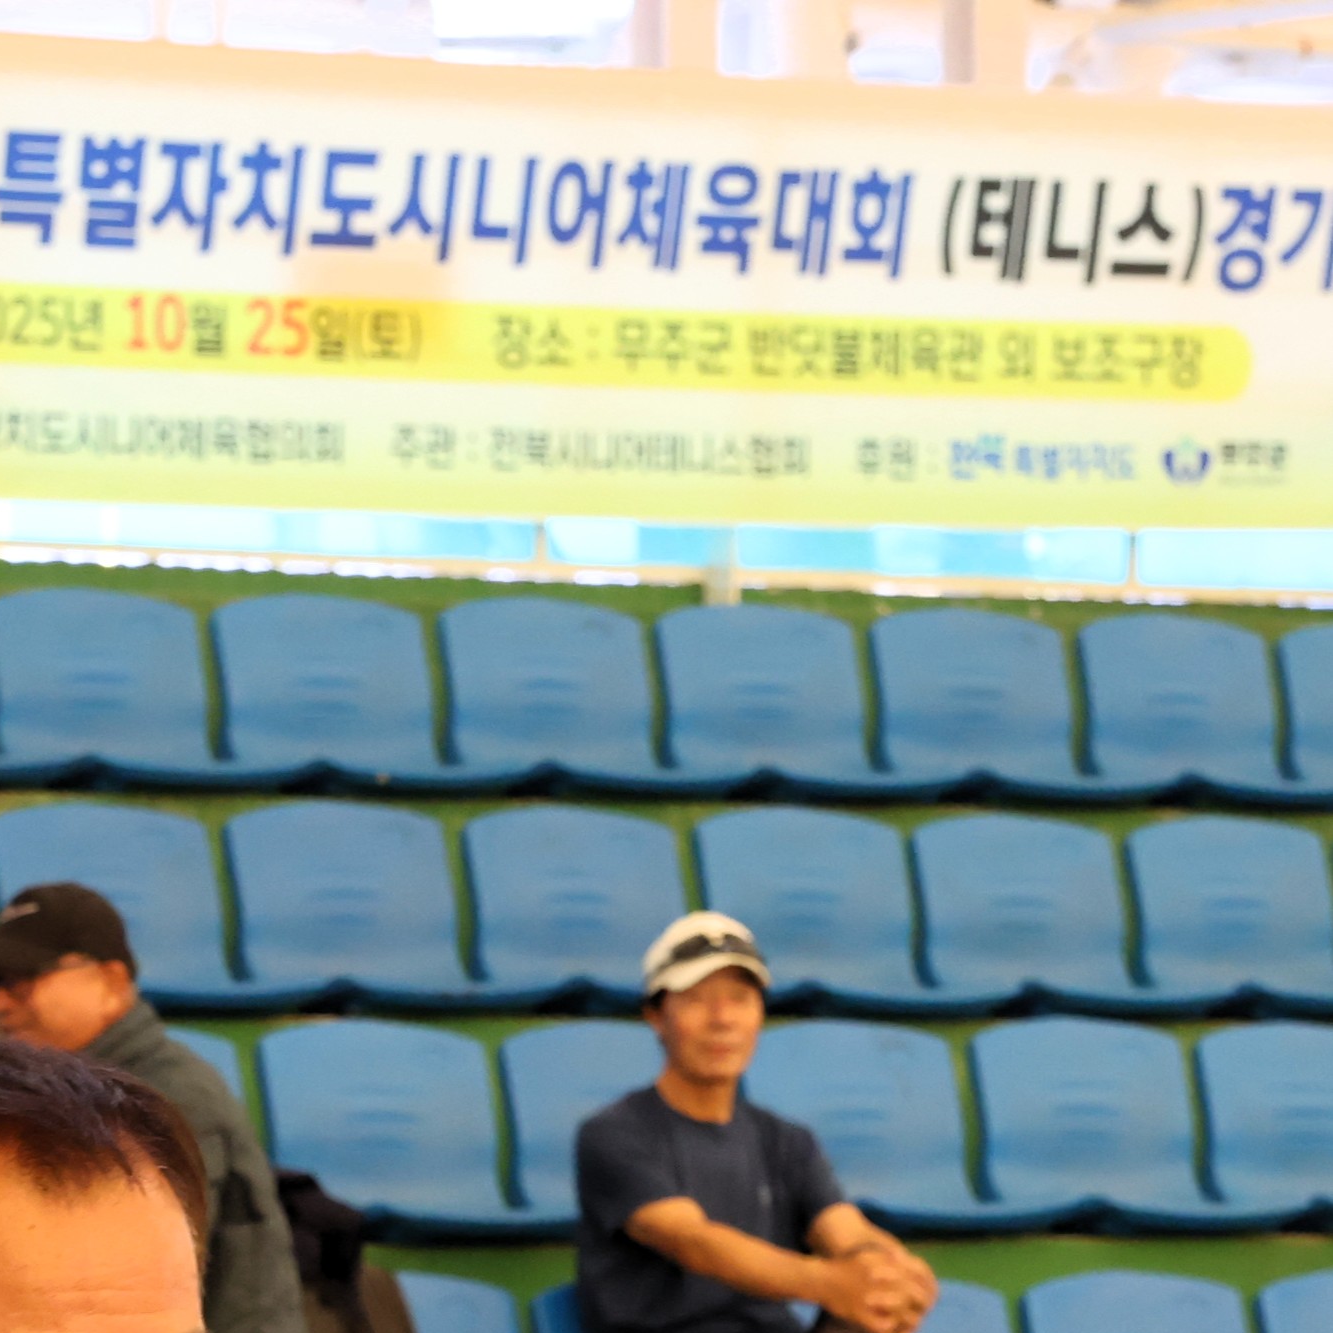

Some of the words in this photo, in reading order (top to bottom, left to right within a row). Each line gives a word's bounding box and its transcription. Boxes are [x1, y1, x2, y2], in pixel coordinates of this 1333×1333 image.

[125, 292, 227, 359] 10월
[246, 296, 422, 363] 25일(토)
[492, 314, 573, 371] 장소
[1052, 331, 1205, 390] 보조구장
